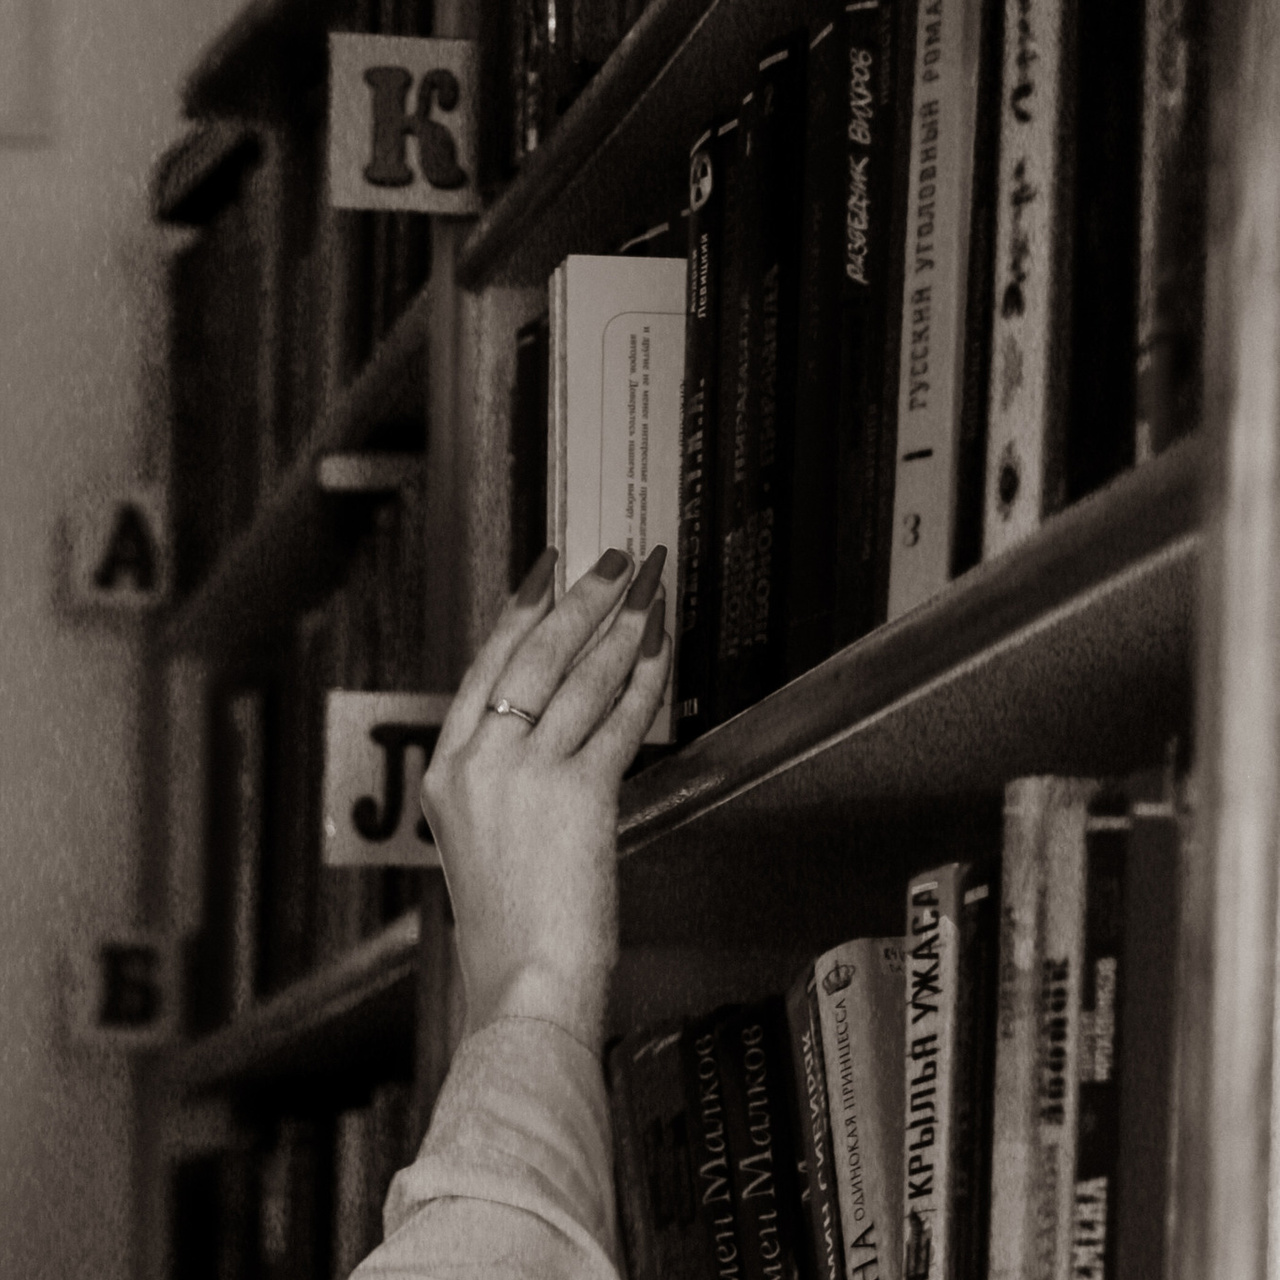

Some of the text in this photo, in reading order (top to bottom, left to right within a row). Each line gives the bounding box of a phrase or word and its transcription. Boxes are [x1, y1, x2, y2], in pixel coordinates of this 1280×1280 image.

[363, 65, 468, 190] К
[846, 47, 873, 284] РАЗВЕДЧИК ВИХРОВ
[915, 99, 939, 275] УГОЛОВНЫЙ
[697, 233, 709, 318] Левицкий
[639, 337, 650, 371] другие
[626, 379, 639, 437] Доверьтесь
[639, 390, 649, 420] менее
[626, 440, 637, 479] нашему
[639, 424, 649, 483] интересные
[94, 503, 156, 589] А
[625, 483, 637, 520] выбору
[834, 997, 857, 1110] ПРИНЦЕССА
[693, 1033, 732, 1205] Малков
[738, 1023, 776, 1201] Малков
[907, 1033, 939, 1200] КРЫЛЬЯ
[845, 1116, 867, 1221] ОДИНОКАЯ
